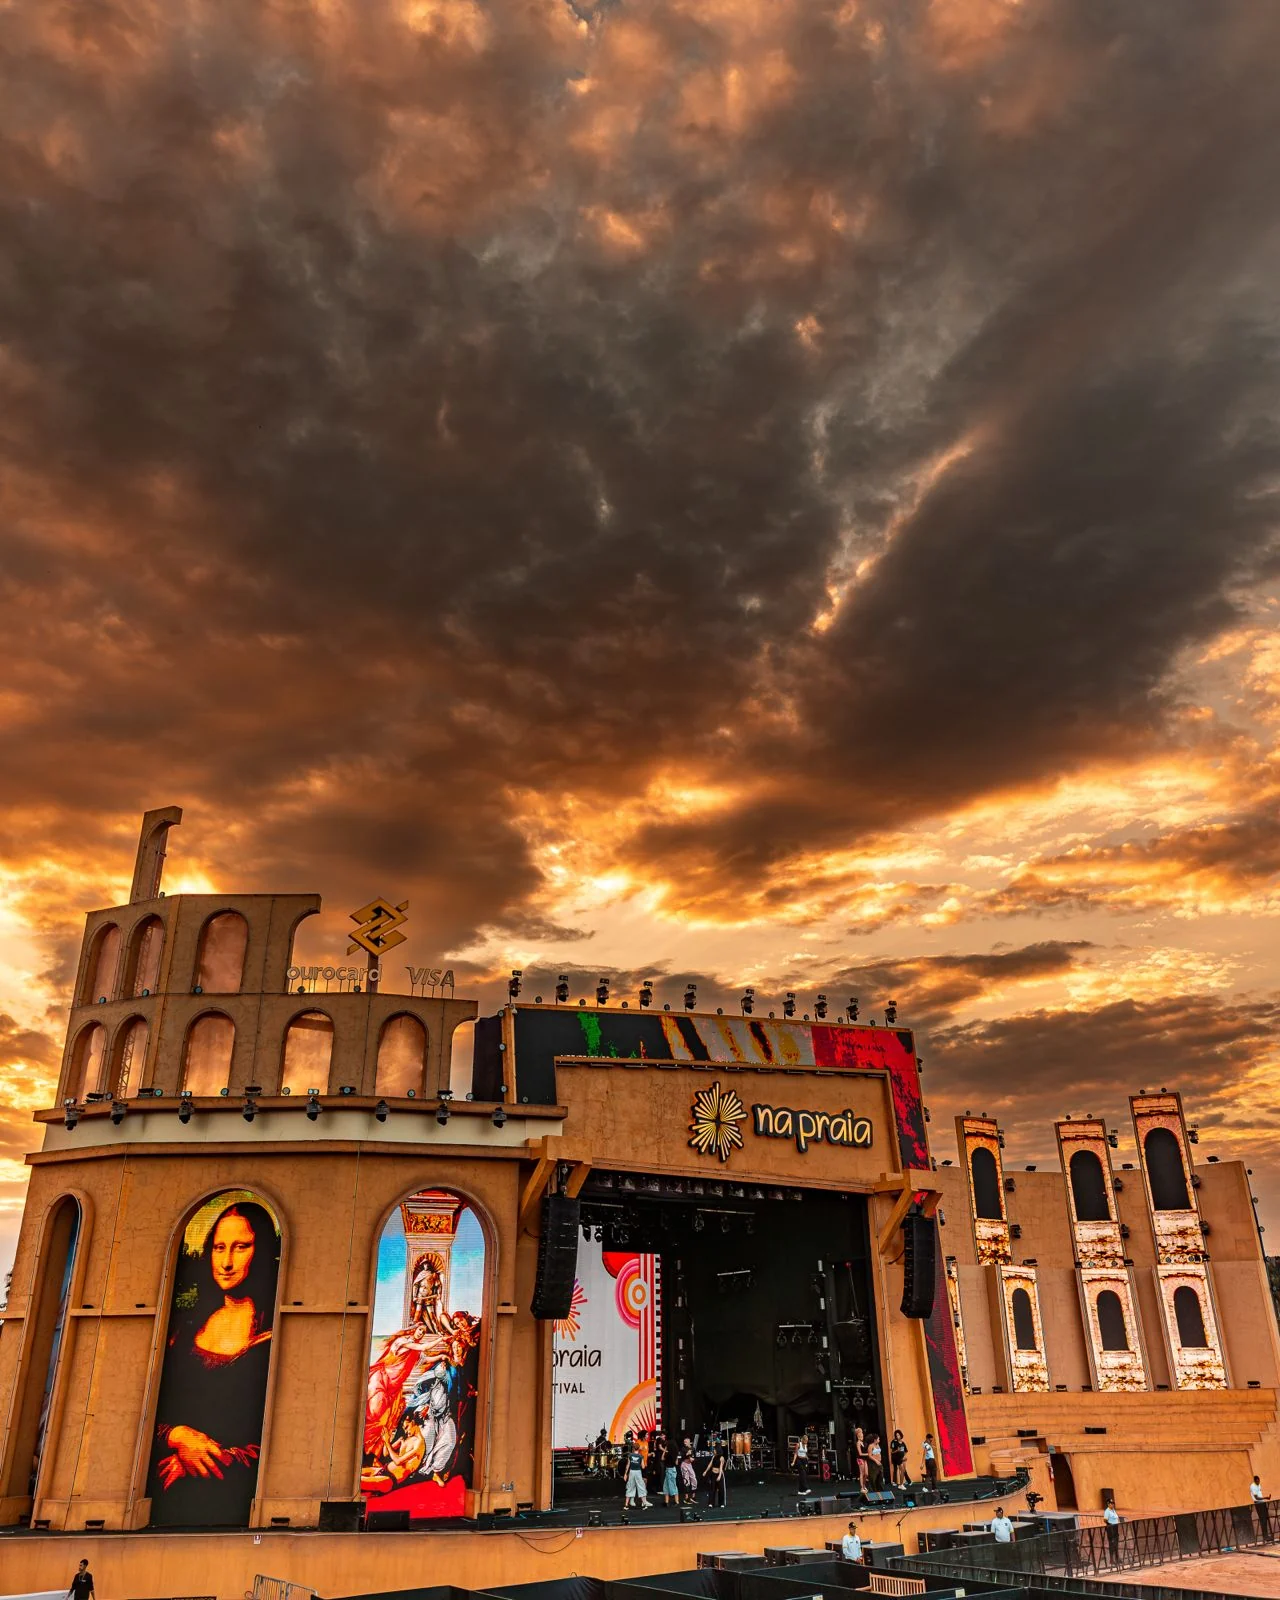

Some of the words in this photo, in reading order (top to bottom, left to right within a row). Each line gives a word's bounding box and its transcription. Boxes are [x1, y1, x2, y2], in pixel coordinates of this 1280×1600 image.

[287, 964, 382, 982] ourocard
[405, 966, 455, 987] VISA
[755, 1105, 793, 1136] na
[798, 1111, 871, 1150] praia
